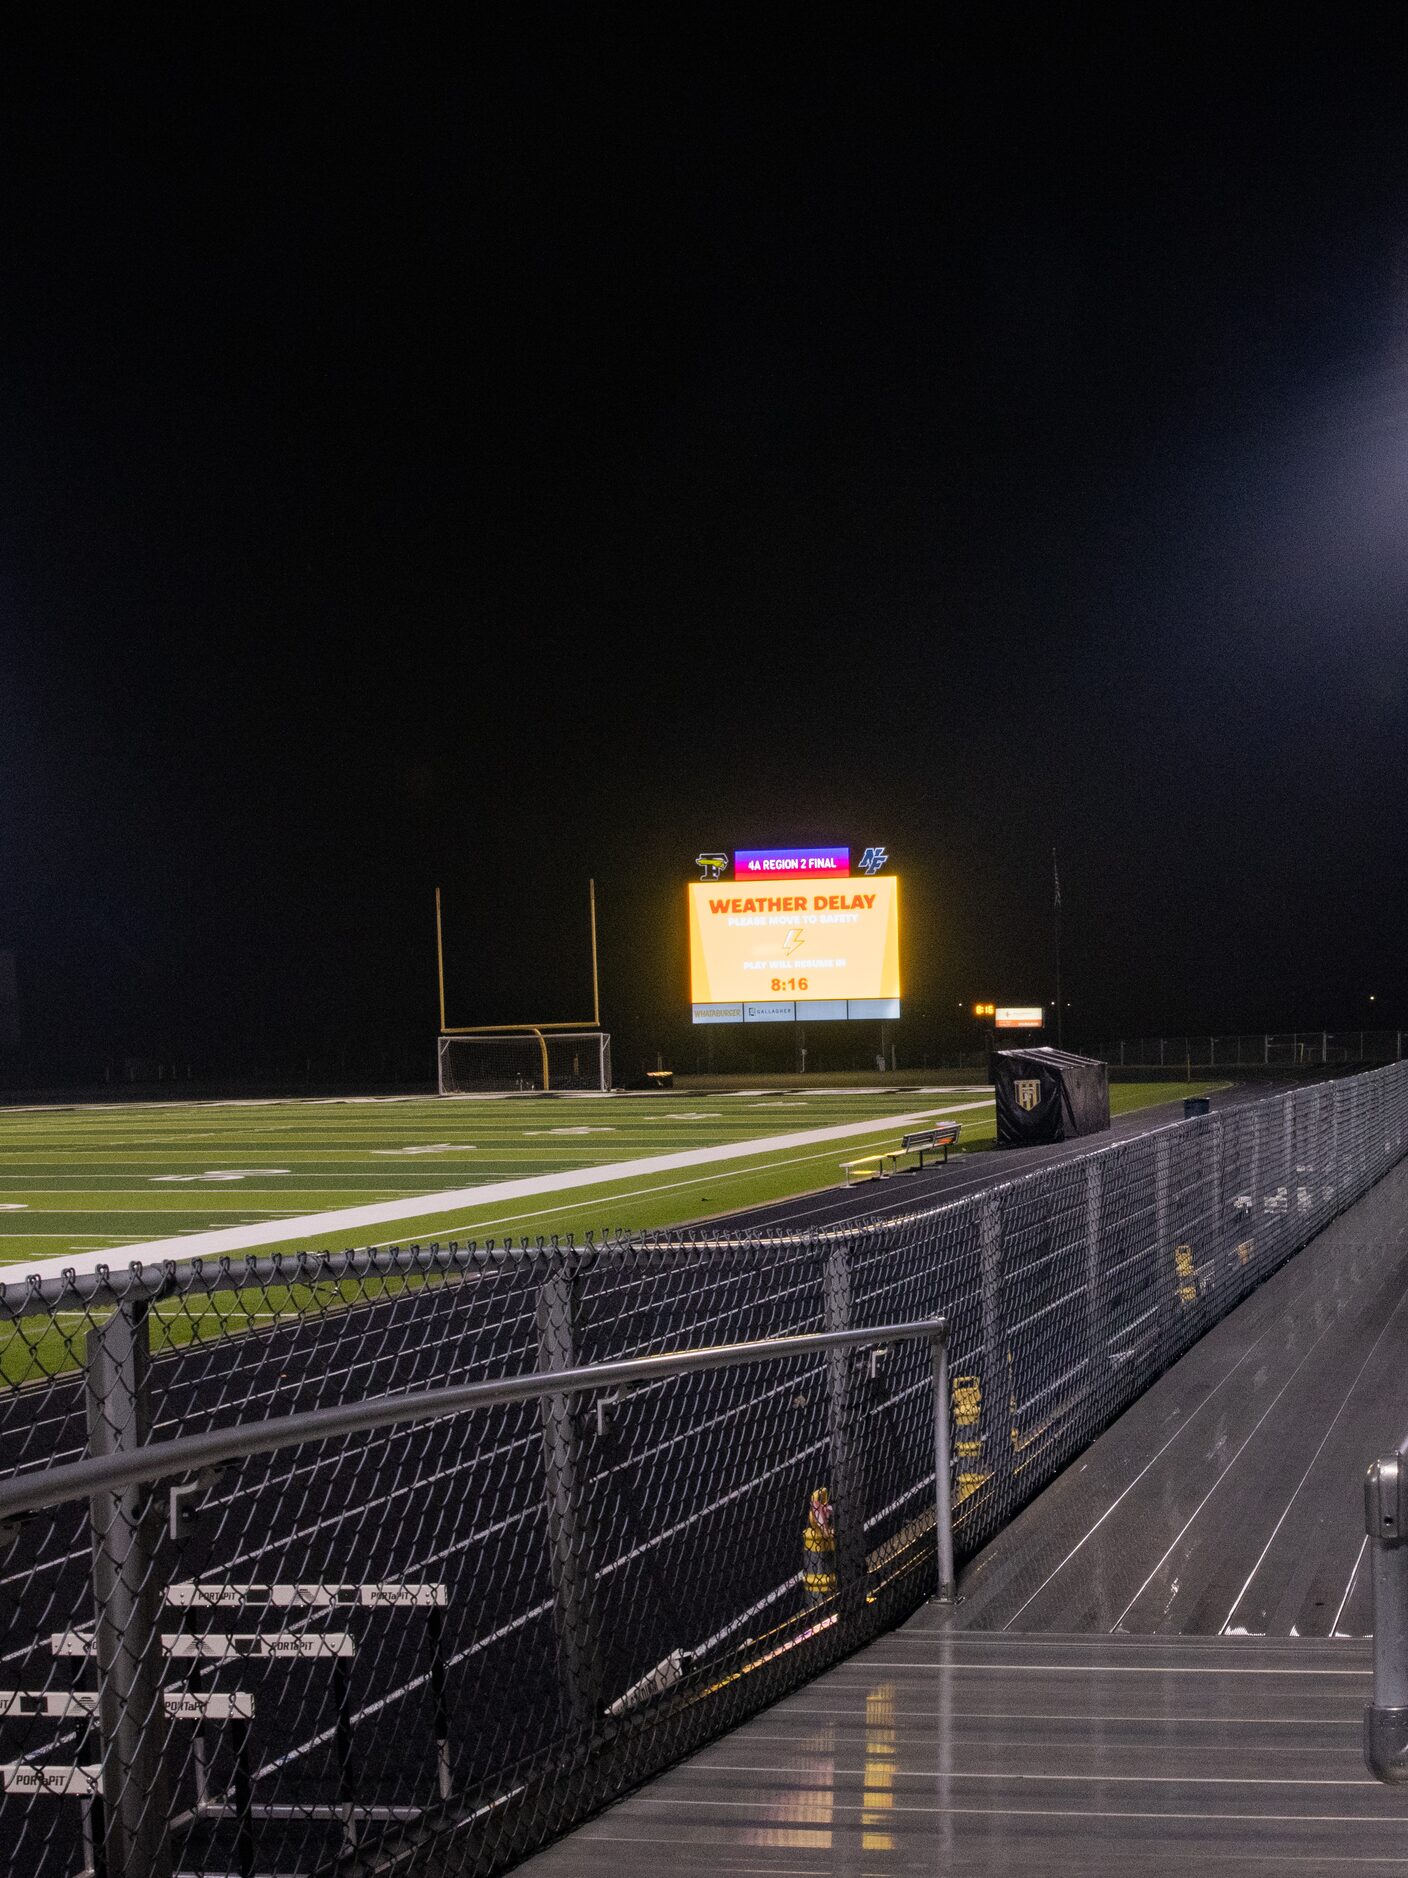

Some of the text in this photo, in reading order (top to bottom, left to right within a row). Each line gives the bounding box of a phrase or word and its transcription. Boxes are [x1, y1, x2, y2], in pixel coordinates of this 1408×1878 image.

[748, 857, 837, 871] 4A REGION 2 FINAL
[709, 894, 876, 914] WEATHER DELAY
[728, 916, 767, 927] PLEASE
[769, 915, 800, 925] MOVE
[802, 914, 817, 925] TO
[769, 960, 792, 970] WILL
[771, 978, 808, 991] 8:16
[165, 1701, 208, 1711] PORTaP
[16, 1775, 65, 1786] PORaPiT
